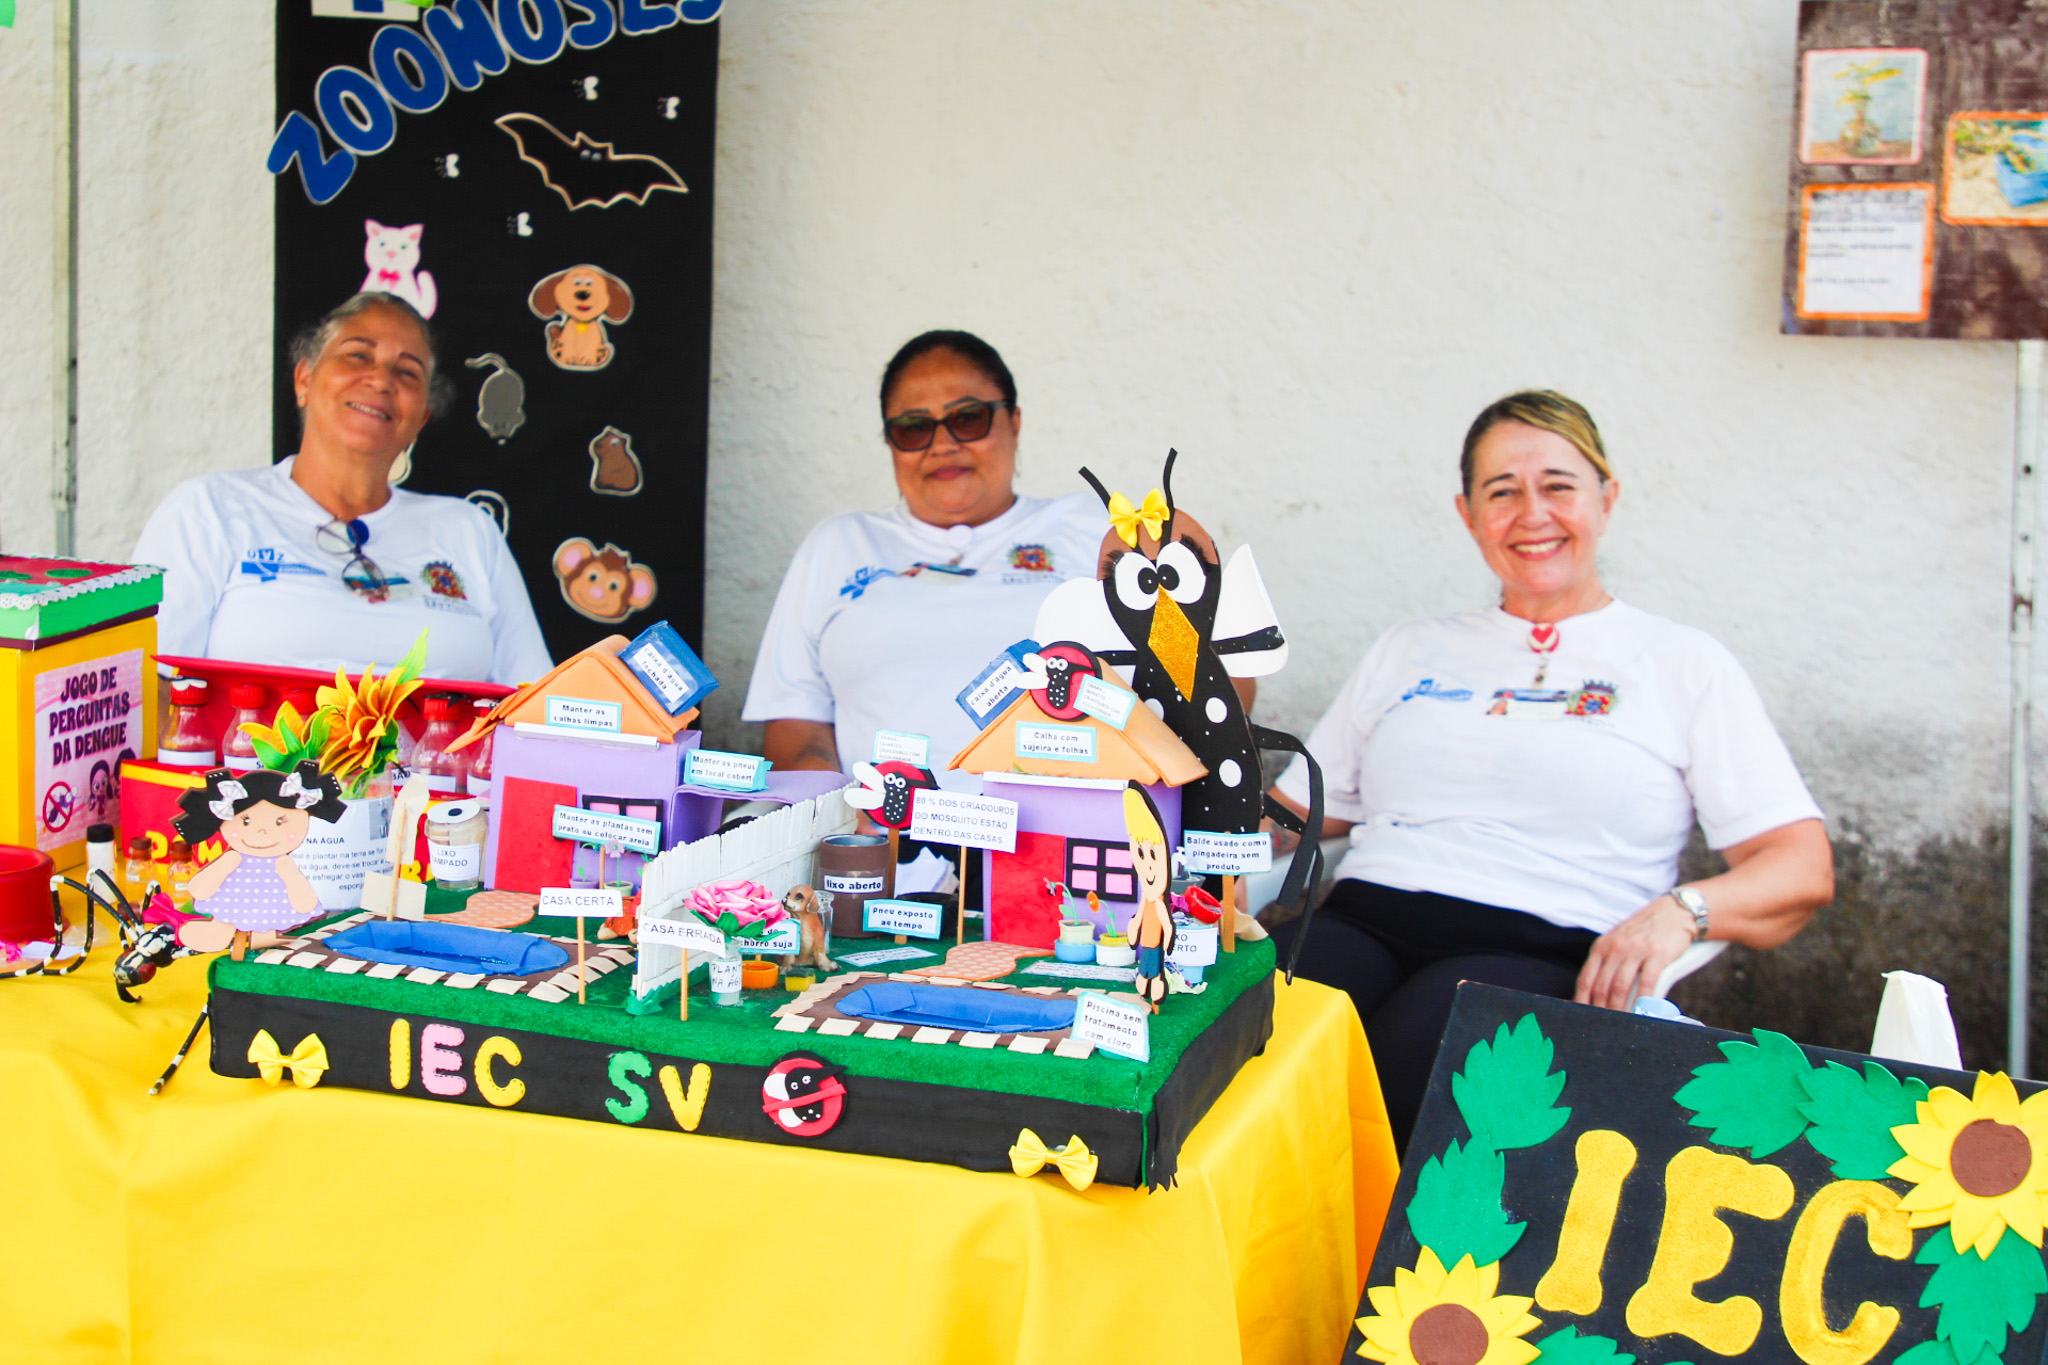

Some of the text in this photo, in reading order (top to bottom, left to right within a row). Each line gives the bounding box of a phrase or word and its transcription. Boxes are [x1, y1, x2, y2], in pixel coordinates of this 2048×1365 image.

[60, 666, 118, 702] JOGO DE
[986, 686, 1008, 707] aberta
[48, 690, 130, 736] PERGUNTAS
[562, 704, 593, 714] Manter
[554, 716, 613, 727] calhas limpas
[1034, 732, 1058, 740] Calha
[52, 722, 128, 766] DA DENGUE
[1023, 744, 1052, 752] sujeira
[1062, 746, 1088, 755] folhas
[692, 756, 720, 766] Manter
[734, 761, 755, 770] pneus
[706, 769, 724, 778] local
[916, 797, 1014, 816] 80 % DOS CRIADOUROS
[560, 812, 588, 823] Manter
[602, 820, 633, 831] plantas
[636, 827, 653, 835] sem
[914, 812, 1008, 830] DO MOSQUITO ESTÃO
[558, 824, 579, 834] prato
[595, 831, 627, 840] colocar
[629, 837, 650, 846] areia
[913, 826, 1003, 844] DENTRO DAS CASAS
[1187, 836, 1210, 845] Balde
[312, 852, 338, 860] plantar
[352, 850, 366, 858] terra
[437, 849, 456, 857] LIXO
[1192, 850, 1238, 859] pingadeira
[332, 861, 360, 870] deve-se
[432, 855, 468, 866] TAMPADO
[312, 873, 343, 881] esfregar
[826, 880, 882, 890] lixo aberto
[542, 895, 614, 906] CASA CERTA
[873, 906, 933, 919] Pneu exposto
[894, 920, 922, 930] tempo
[643, 922, 722, 946] CASA ERRADA
[773, 940, 792, 949] suja
[1087, 1000, 1142, 1024] Piscina sem
[1084, 1014, 1138, 1037] tratamento
[1085, 1030, 1132, 1049] com cloro
[390, 1017, 714, 1132] IEC SV
[1534, 1128, 1914, 1365] IEC
